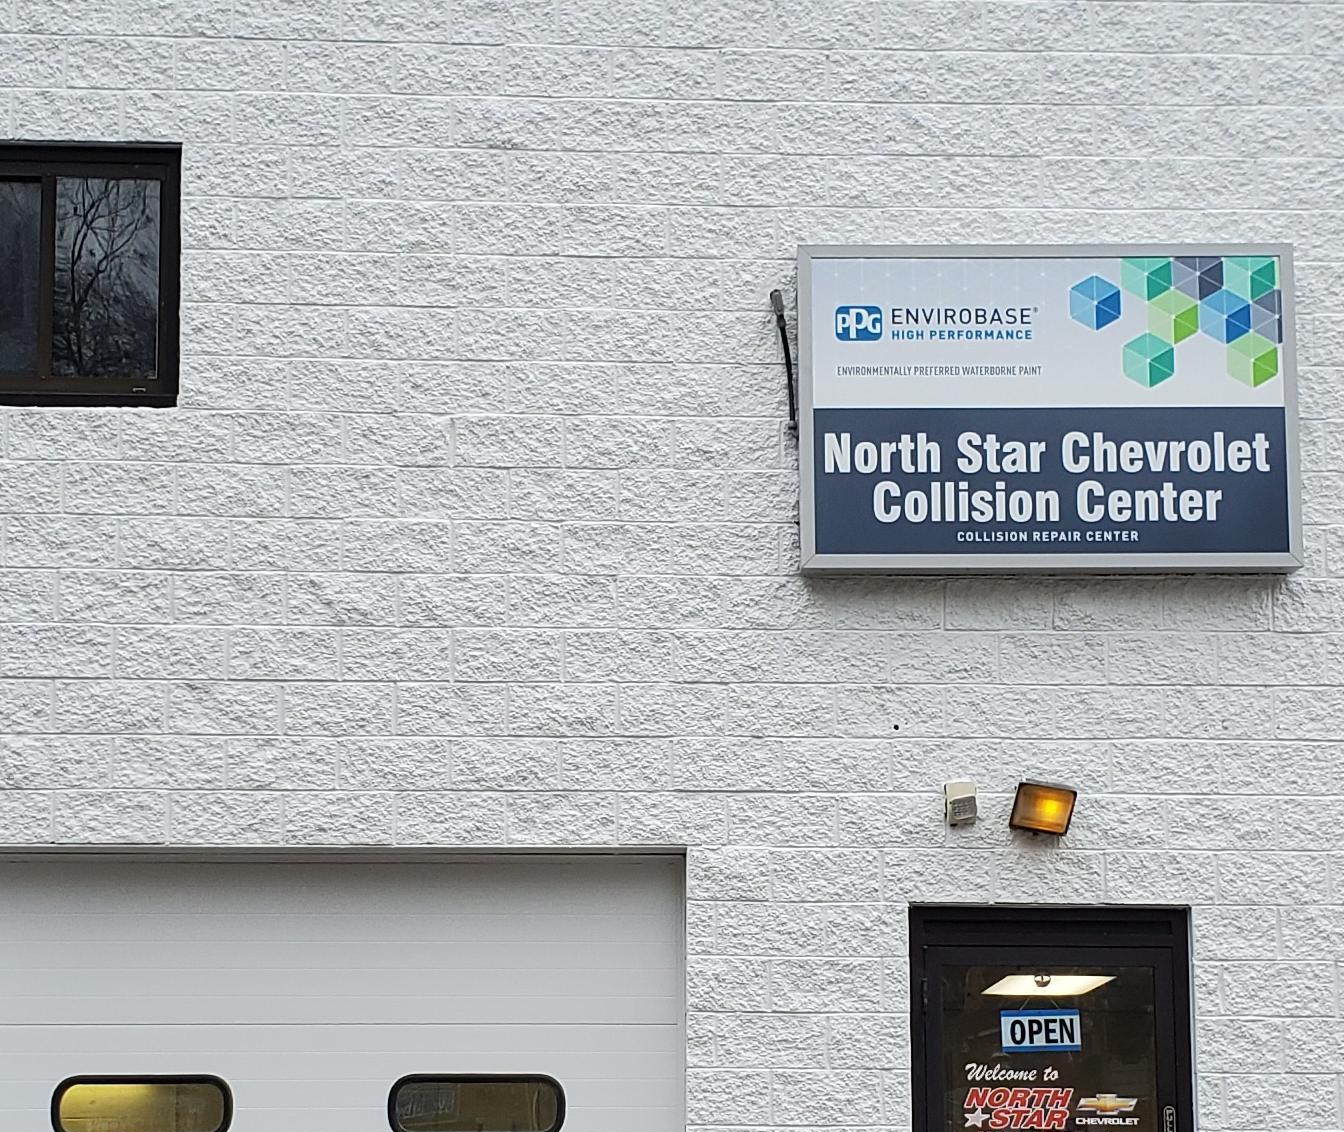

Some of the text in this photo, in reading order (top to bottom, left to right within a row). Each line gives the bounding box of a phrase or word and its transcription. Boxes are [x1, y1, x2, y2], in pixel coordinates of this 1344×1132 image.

[837, 308, 881, 339] PPG
[892, 330, 1033, 340] HIGH PERFORMANCE
[837, 366, 1042, 376] ENVIRONMENTALLY PREFERRED WATERBORNE PAINT
[824, 430, 1271, 473] North Star Chevrolet
[873, 480, 1223, 523] Collision Center
[957, 530, 1140, 543] COLLISION REPAIR CENTER
[1010, 1019, 1076, 1046] OPEN
[964, 1063, 1059, 1081] Welcome to
[964, 1087, 1074, 1109] NORTH
[989, 1108, 1068, 1129] STAR
[1075, 1117, 1140, 1126] CHEVROLET
